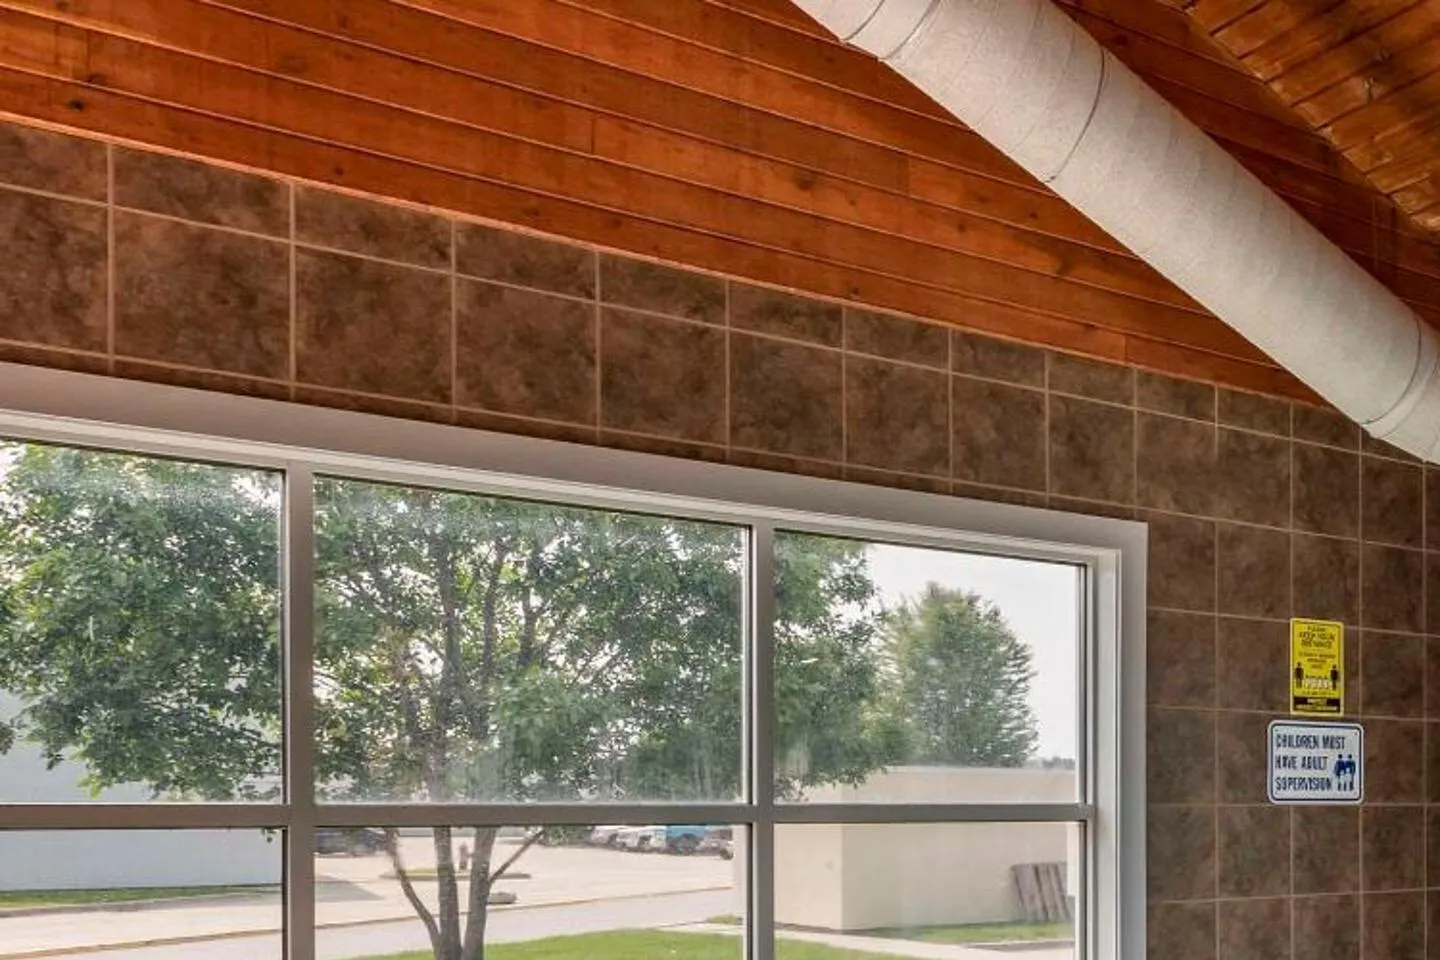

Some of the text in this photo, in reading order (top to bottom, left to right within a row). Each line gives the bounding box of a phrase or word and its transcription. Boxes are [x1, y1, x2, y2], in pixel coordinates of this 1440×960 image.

[1276, 733, 1346, 750] CHILDREN MUST
[1275, 754, 1329, 771] HAVE ADULT
[1275, 776, 1332, 791] SUPERVISION
